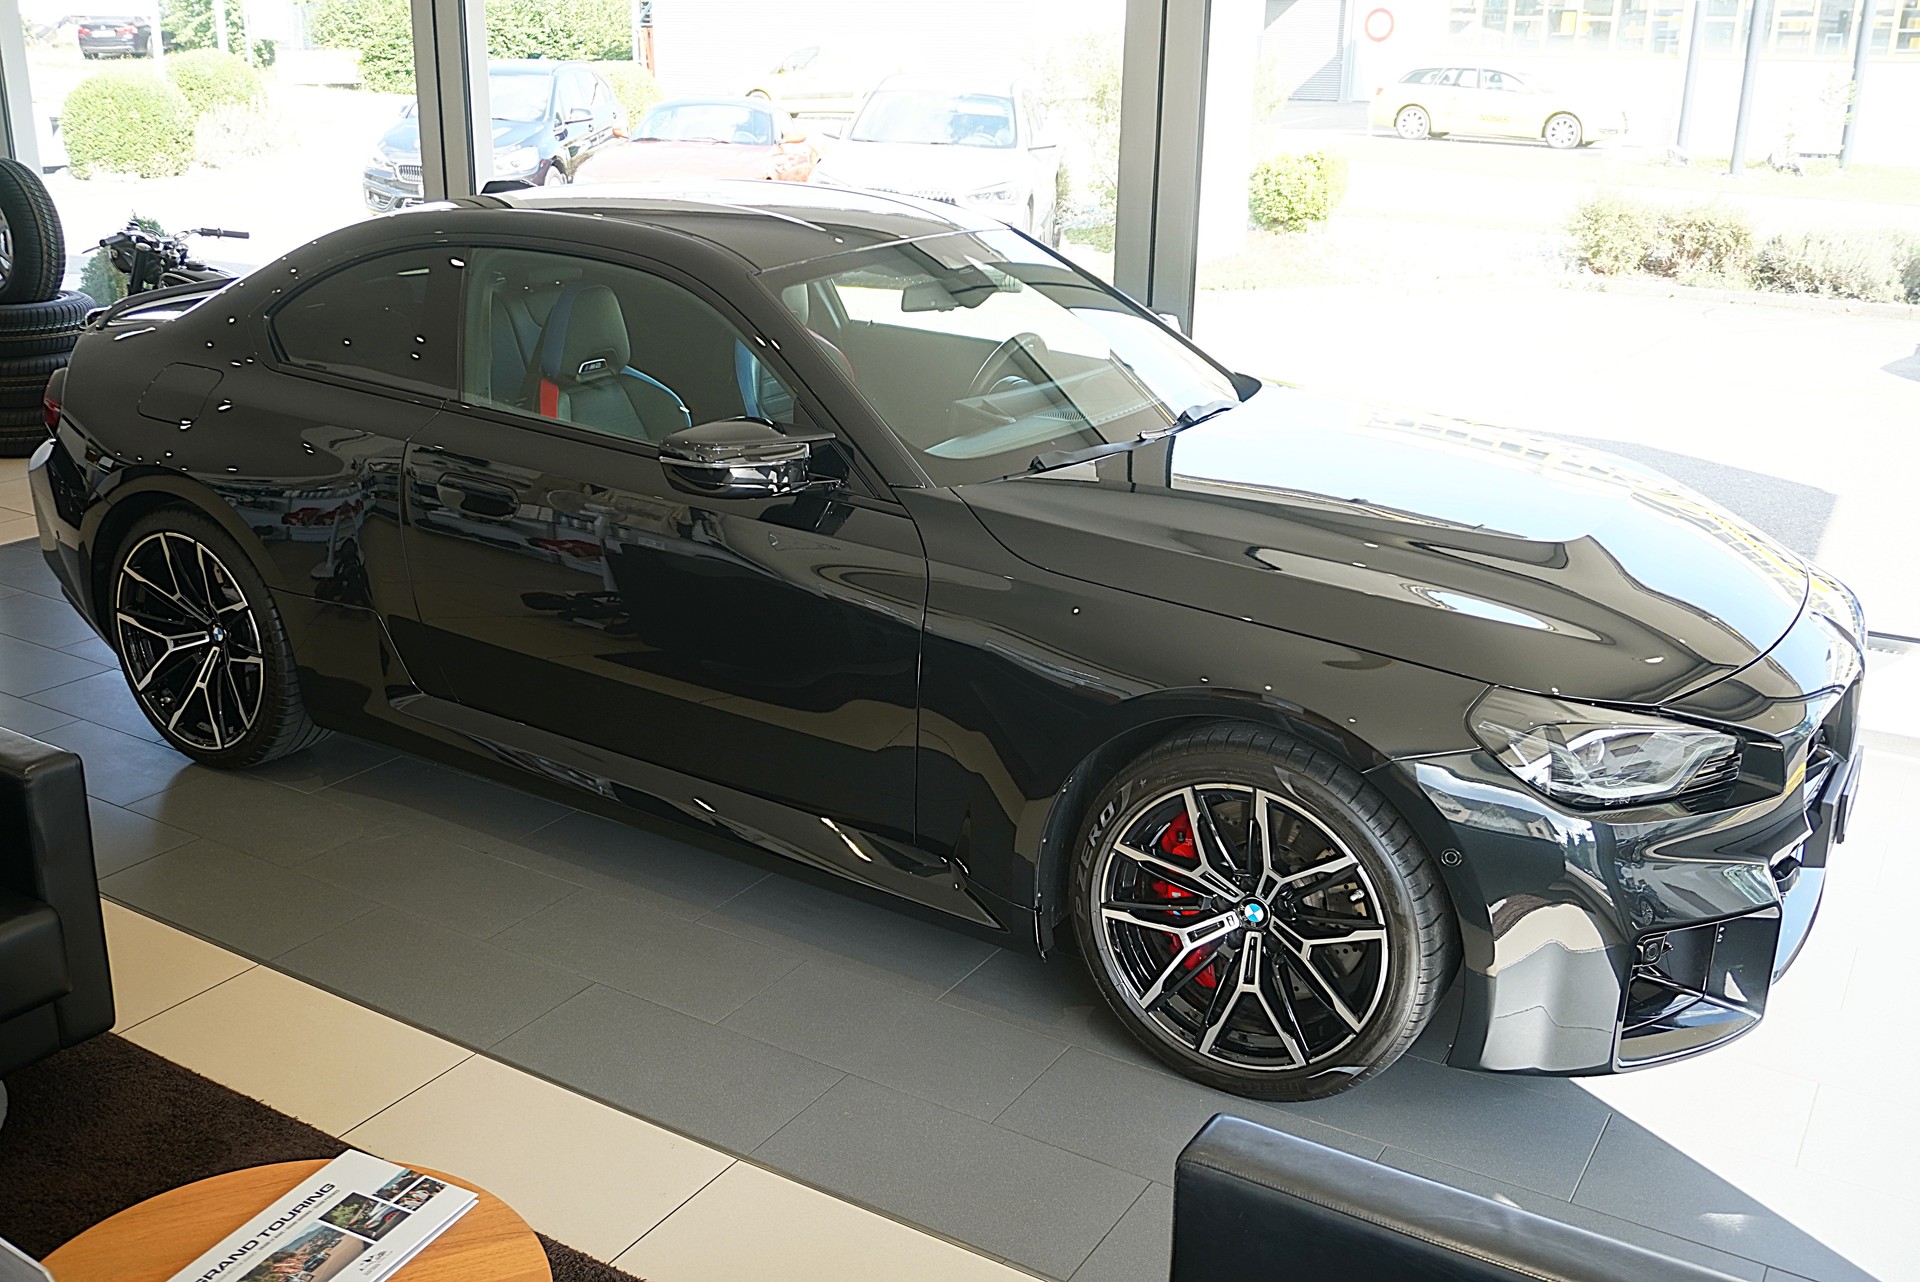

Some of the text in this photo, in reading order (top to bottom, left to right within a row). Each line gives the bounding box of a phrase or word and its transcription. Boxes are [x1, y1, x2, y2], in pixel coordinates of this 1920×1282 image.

[1075, 800, 1116, 922] P ZERO
[256, 1183, 336, 1238] TOURING
